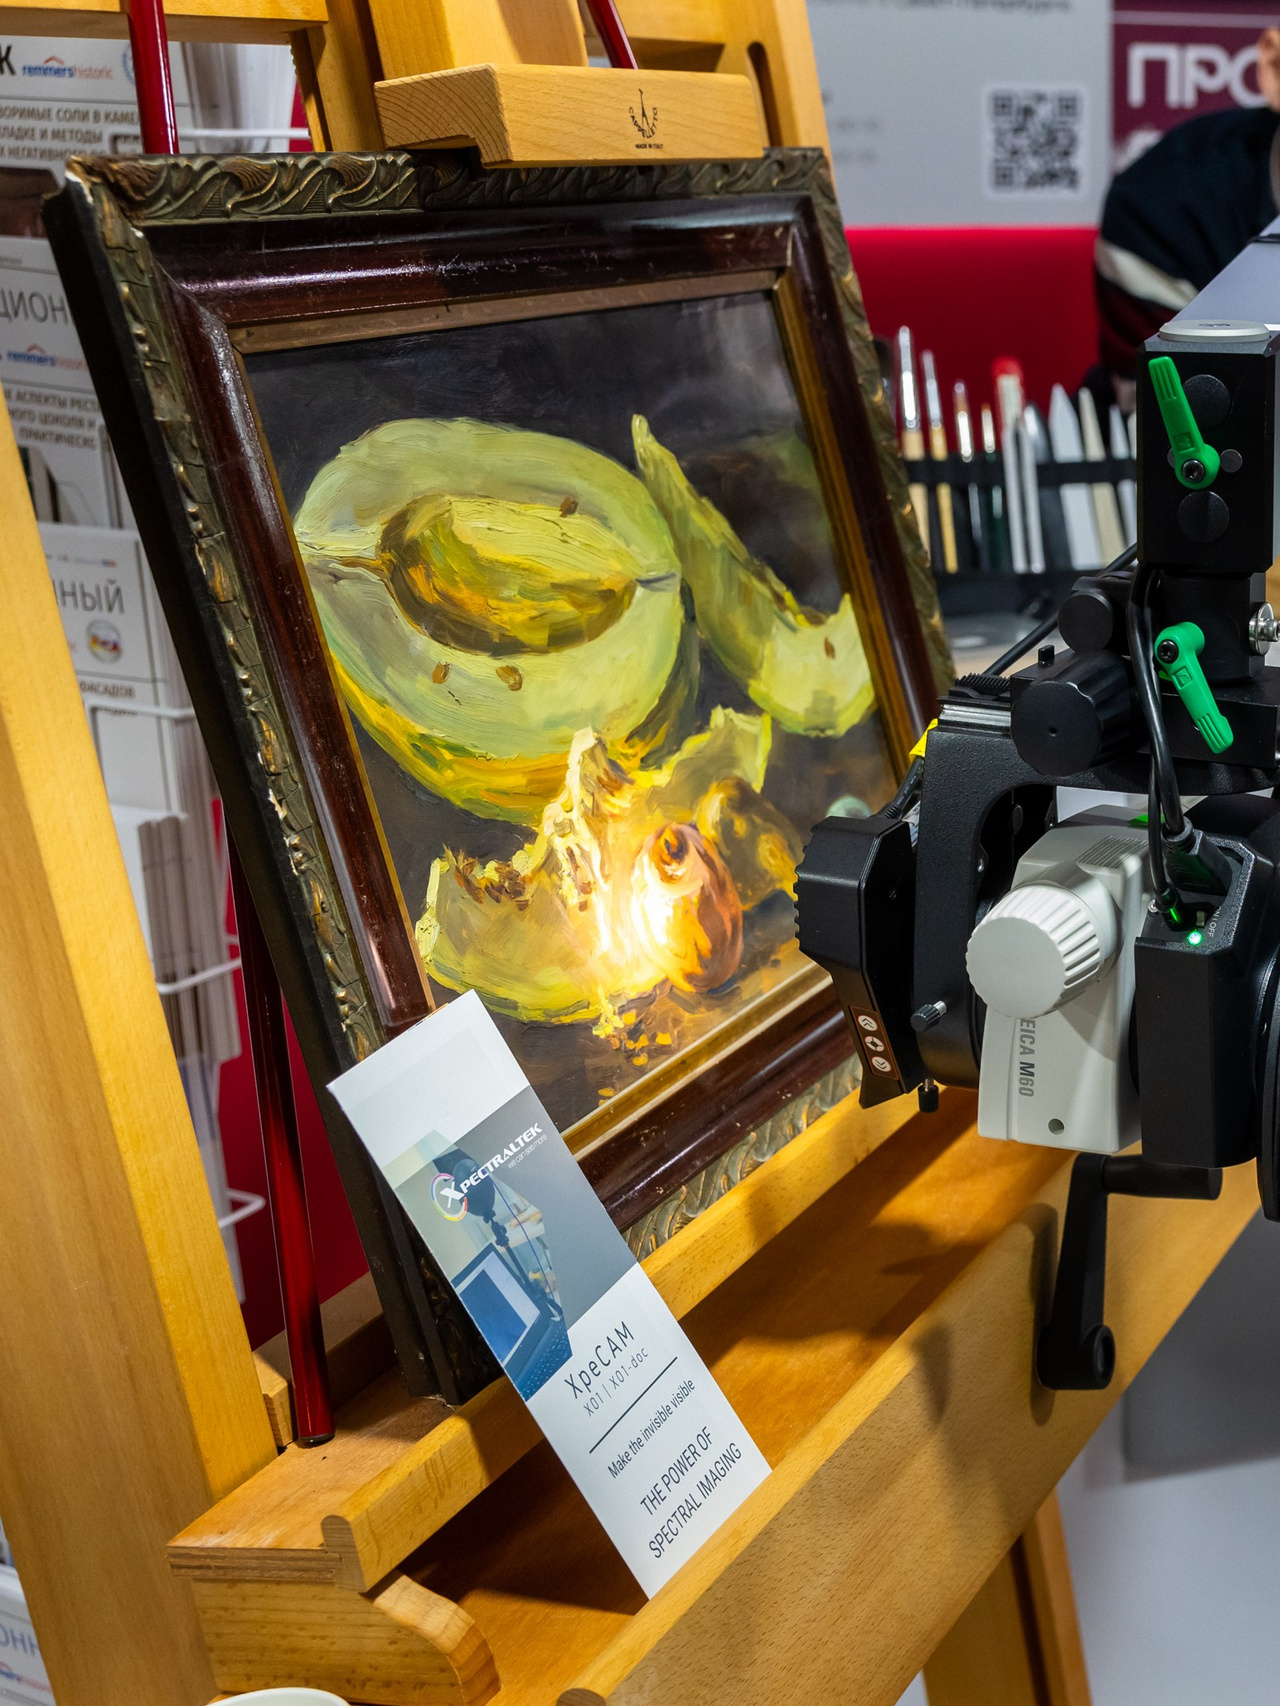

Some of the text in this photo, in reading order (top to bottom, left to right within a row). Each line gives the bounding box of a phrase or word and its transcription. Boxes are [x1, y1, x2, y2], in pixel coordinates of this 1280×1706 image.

[39, 127, 48, 141] И
[51, 127, 103, 143] МЕТОДЫ
[56, 106, 90, 122] СОЛИ
[92, 109, 101, 123] В
[15, 389, 68, 409] АСПЕКТЫ
[1207, 921, 1217, 938] OFF
[1018, 1018, 1036, 1098] EICA M60
[506, 1133, 548, 1169] we can see more
[563, 1320, 635, 1400] XpeCAM
[583, 1391, 604, 1418] X01
[608, 1347, 649, 1390] X01-doc
[607, 1379, 696, 1479] Make the invisible visible
[640, 1425, 713, 1516] THE POWER OF
[648, 1442, 742, 1559] SPECTRAL IMAGING
